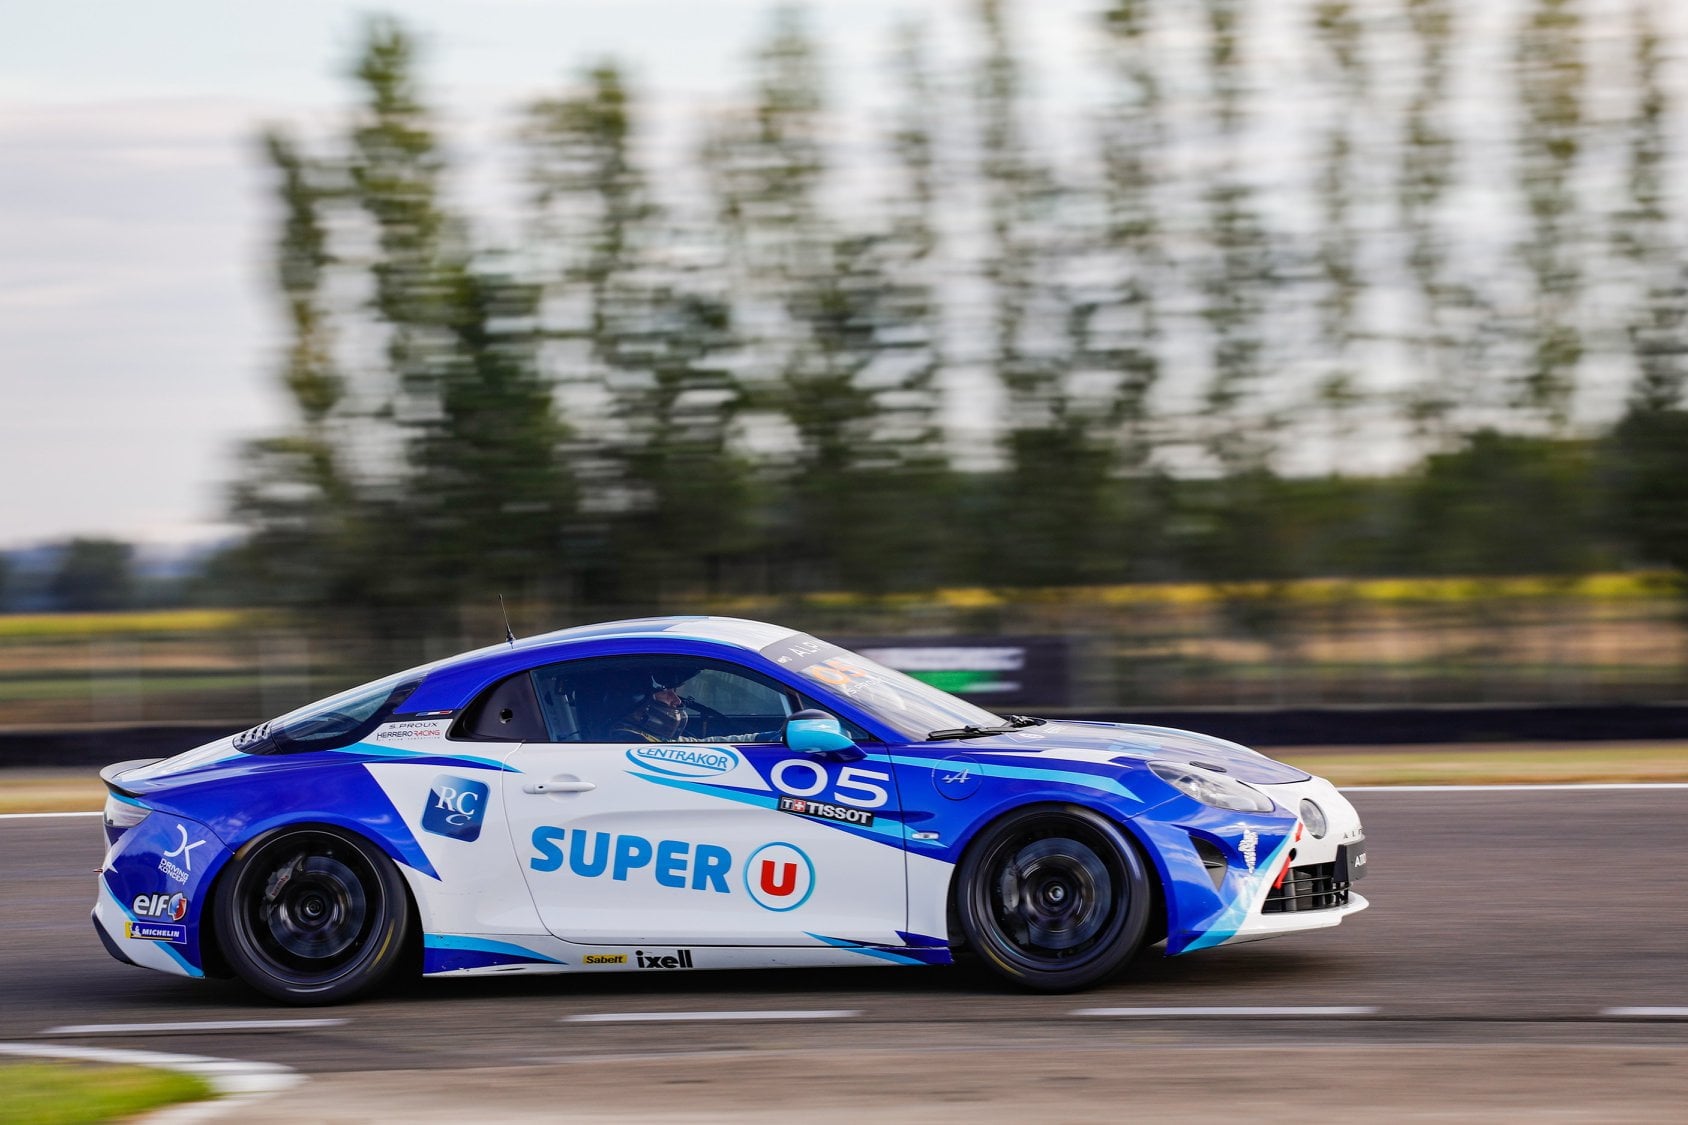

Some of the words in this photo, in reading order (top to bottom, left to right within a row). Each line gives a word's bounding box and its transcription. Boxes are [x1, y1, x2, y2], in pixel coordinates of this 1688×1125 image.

[770, 758, 890, 808] 05
[806, 801, 872, 824] TISSOT
[530, 825, 732, 894] SUPER
[760, 860, 797, 897] U
[133, 894, 170, 917] elf
[141, 927, 180, 938] MICHELIN
[586, 955, 623, 964] Sabelt
[635, 949, 693, 968] ixell
